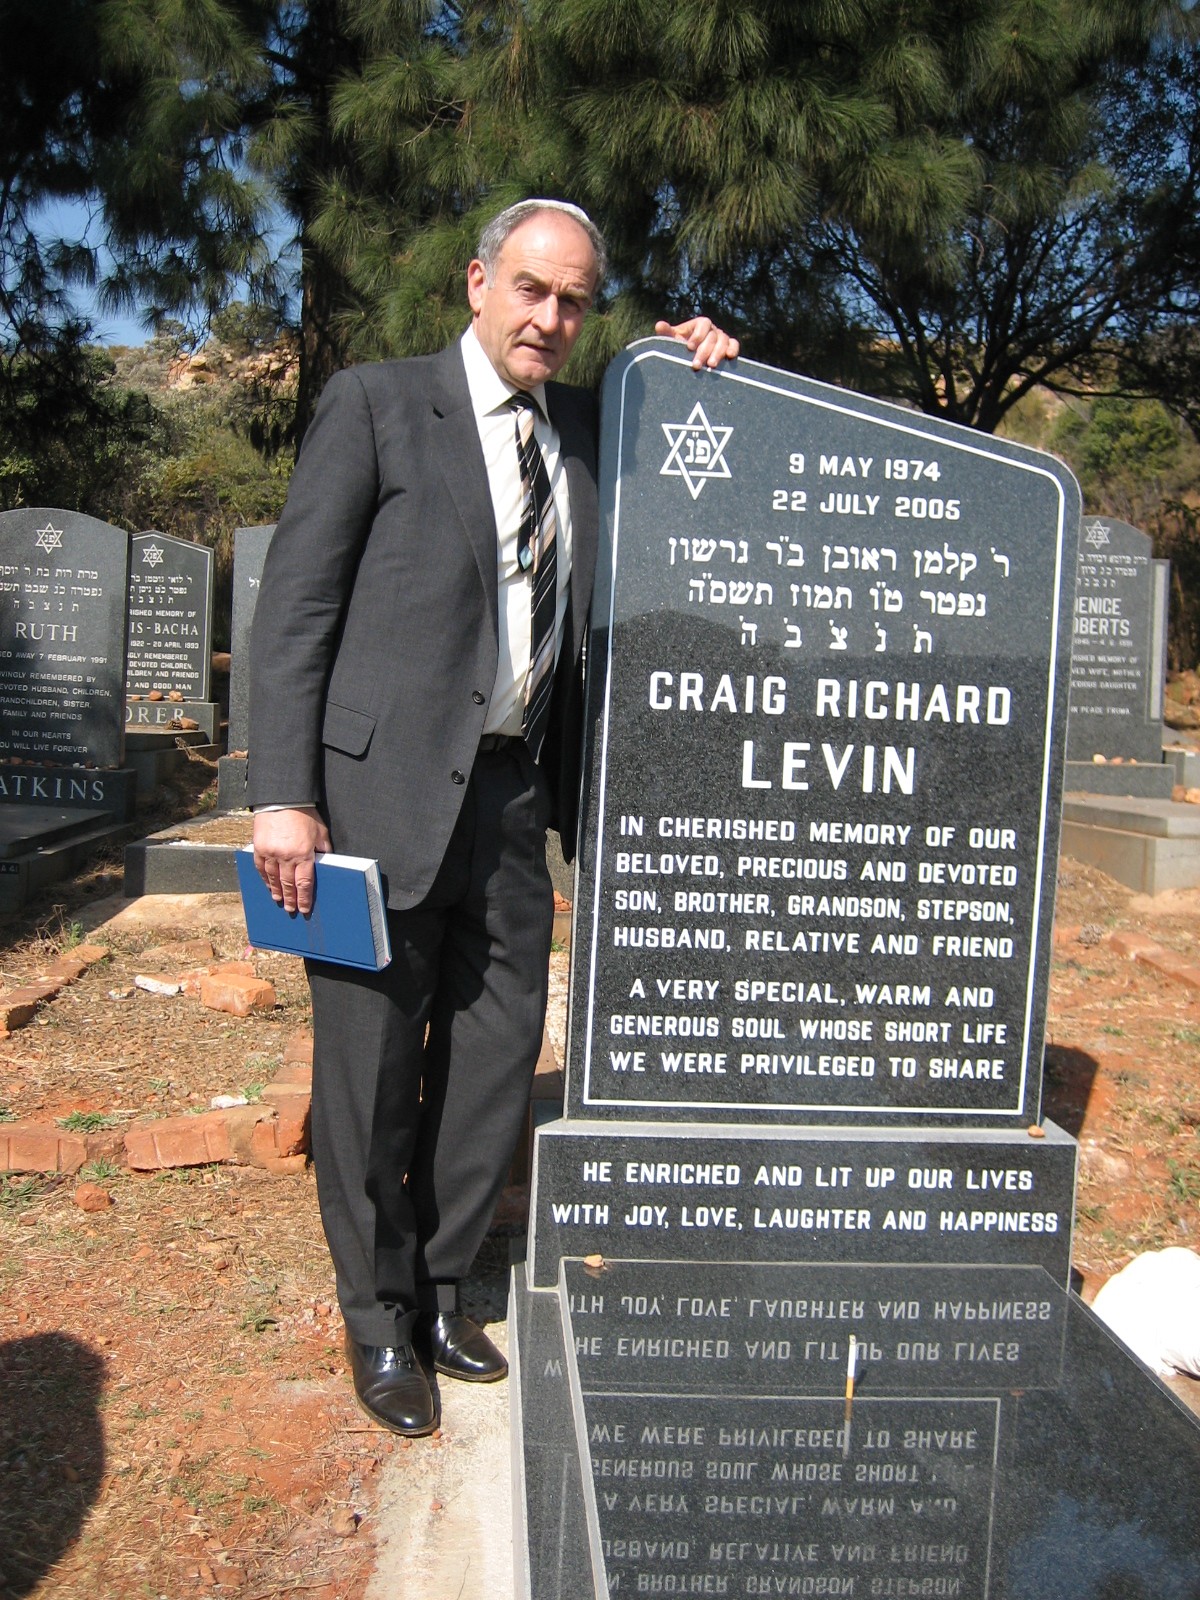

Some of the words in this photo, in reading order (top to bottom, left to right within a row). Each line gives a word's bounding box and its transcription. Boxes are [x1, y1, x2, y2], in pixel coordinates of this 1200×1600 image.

[789, 453, 804, 473] 9
[820, 455, 873, 477] MAY
[885, 459, 941, 481] 1974
[773, 490, 806, 511] 22
[820, 493, 880, 515] JULY
[895, 497, 960, 520] 2005
[669, 537, 748, 565] גרשון
[823, 545, 896, 572] ראובן
[913, 543, 977, 581] קלמן
[790, 584, 852, 609] תמוז
[920, 590, 986, 616] נפטר
[15, 622, 78, 642] RUTH
[48, 654, 86, 663] FEBRUARY
[649, 671, 786, 714] CRAIG
[817, 679, 1010, 725] RICHARD
[742, 740, 914, 794] LEVIN
[621, 816, 643, 836] IN
[659, 817, 795, 841] CHERISHED
[810, 822, 911, 845] MEMORY
[926, 827, 955, 846] OF
[969, 828, 1015, 849] OUR
[617, 853, 724, 878] BELOVED,
[738, 857, 847, 880] PRECIOUS
[860, 861, 906, 882] AND
[919, 863, 1017, 886] DEVOTED
[615, 890, 661, 913] SON,
[675, 892, 775, 917] BROTHER,
[788, 895, 905, 921] GRANDSON,
[917, 900, 1014, 925] STEPSON,
[614, 927, 730, 952] HUSBAND,
[746, 930, 860, 953] RELATIVE
[871, 934, 918, 955] AND
[933, 936, 1013, 957] FRIEND
[629, 979, 645, 998] A
[657, 979, 719, 1000] VERY
[735, 979, 845, 1006] SPECIAL,
[858, 984, 930, 1005] WARM
[945, 987, 993, 1007] AND
[611, 1015, 719, 1036] GENEROUS
[732, 1018, 785, 1038] SOUL
[800, 1019, 873, 1040] WHOSE
[885, 1022, 951, 1042] SHORT
[963, 1024, 1006, 1044] LIFE
[610, 1051, 645, 1071] WE
[661, 1053, 727, 1073] WERE
[741, 1054, 875, 1076] PRIVILEGED
[889, 1058, 916, 1077] TO
[929, 1059, 1004, 1079] SHARE
[584, 1162, 612, 1182] HE
[626, 1163, 740, 1185] ENRICHED
[754, 1166, 802, 1186] AND
[816, 1167, 852, 1187] LIT
[866, 1168, 895, 1187] UP
[908, 1169, 952, 1188] OUR
[967, 1170, 1032, 1190] LIVES
[552, 1204, 608, 1224] WITH
[625, 1206, 668, 1229] JOY,
[682, 1207, 742, 1230] LOVE,
[754, 1208, 870, 1229] LAUGHTER
[883, 1211, 926, 1230] AND
[940, 1211, 1057, 1232] HAPPINESS
